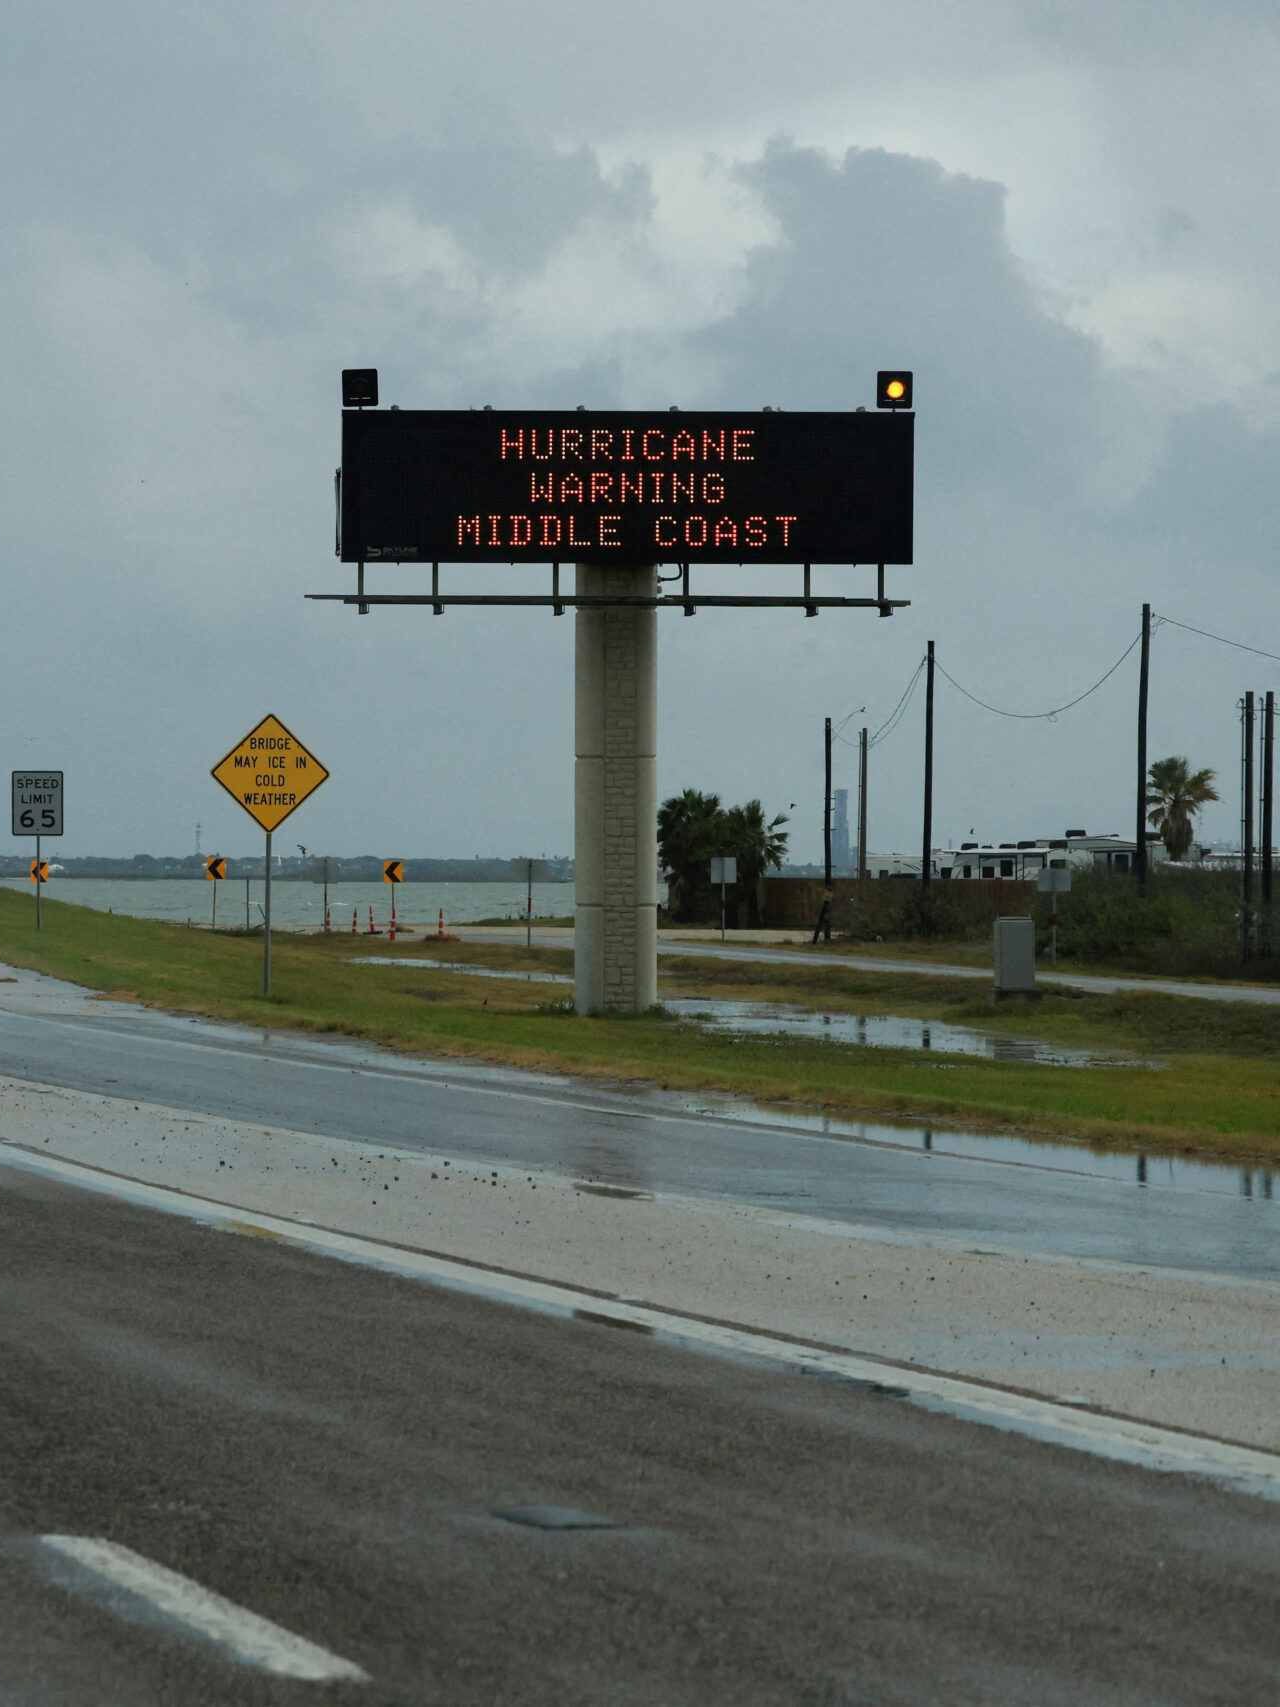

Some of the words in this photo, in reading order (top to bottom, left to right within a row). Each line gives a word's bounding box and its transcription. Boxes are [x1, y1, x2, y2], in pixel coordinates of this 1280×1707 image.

[500, 429, 756, 461] HURRICANE
[530, 472, 725, 504] WARNING
[457, 515, 621, 547] MIDDLE
[654, 515, 798, 547] COAST
[249, 737, 291, 750] BRIDGE
[234, 756, 258, 768] MAY
[268, 756, 286, 768] ICE
[295, 756, 307, 768] IN
[16, 778, 59, 789] SPEED
[255, 774, 286, 787] COLD
[21, 794, 55, 804] LIMIT
[243, 793, 297, 806] WEATHER
[20, 809, 56, 828] 65
